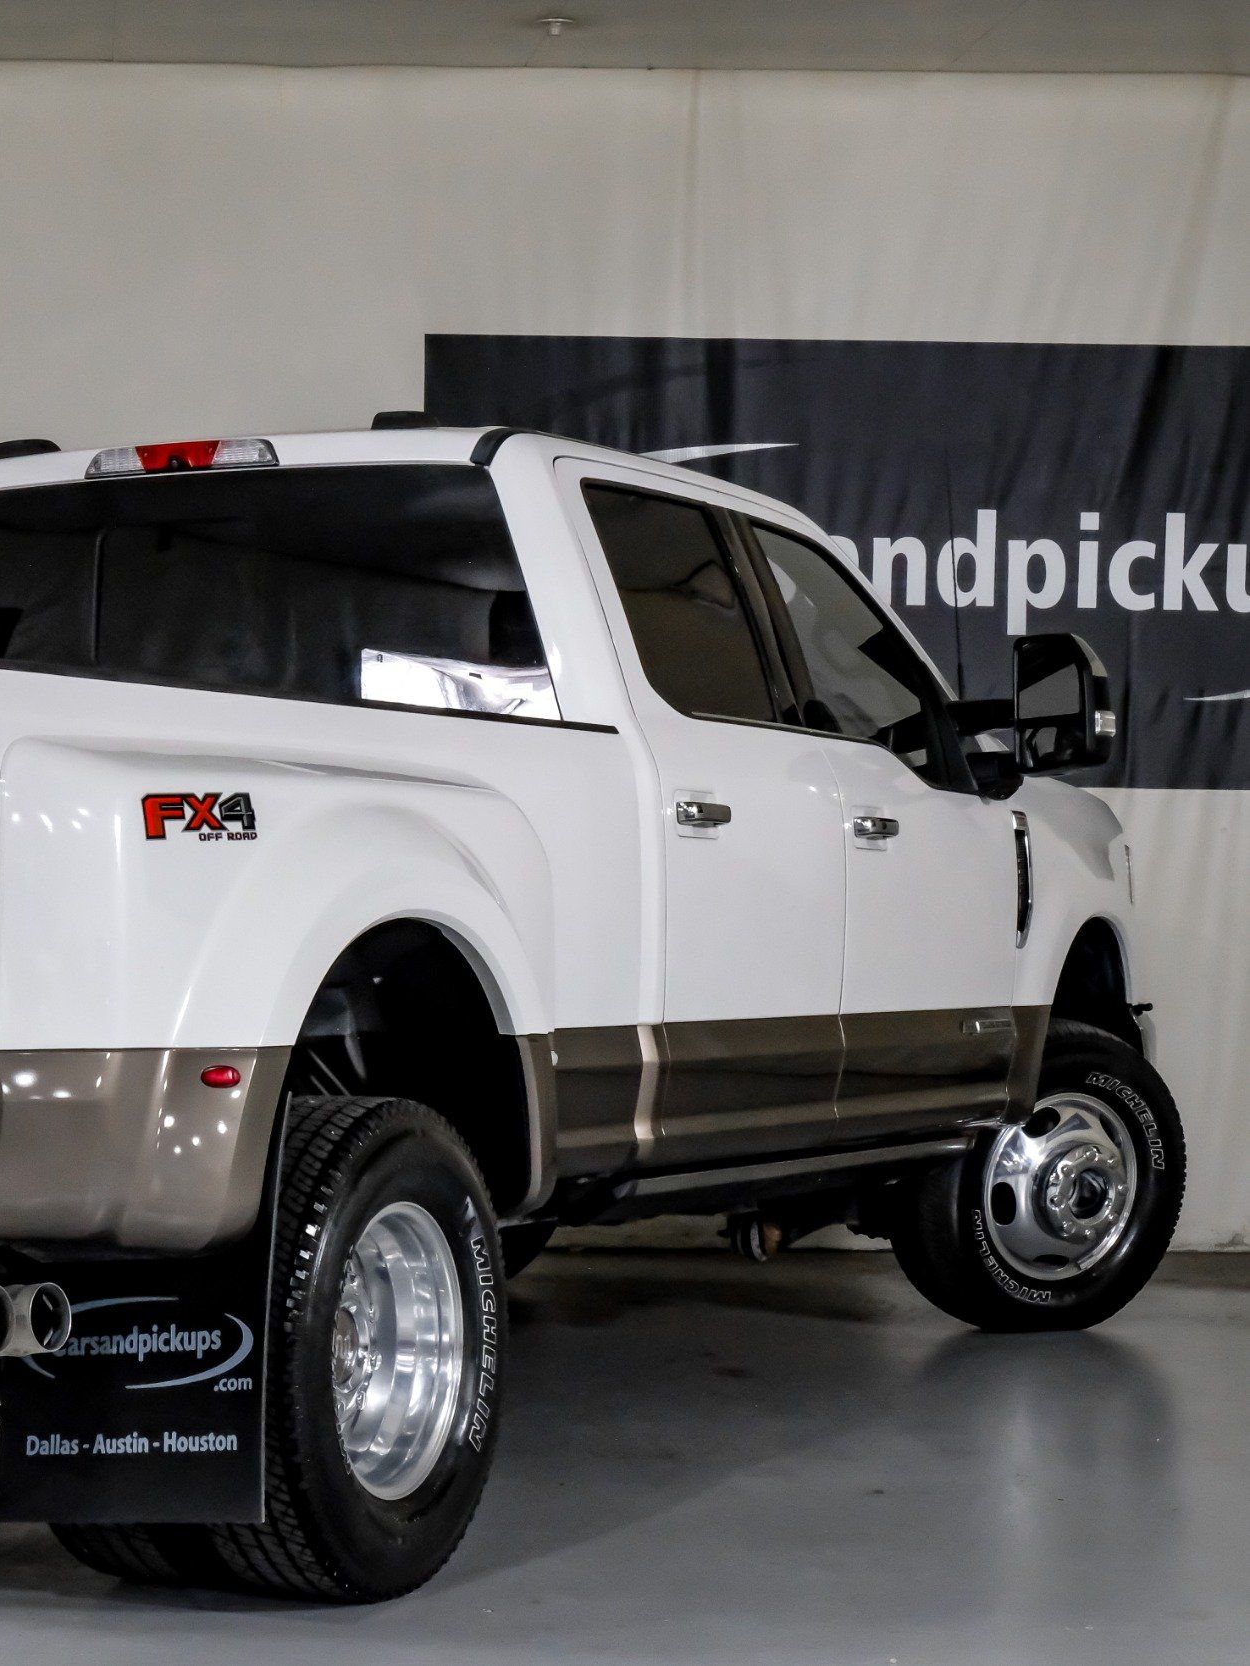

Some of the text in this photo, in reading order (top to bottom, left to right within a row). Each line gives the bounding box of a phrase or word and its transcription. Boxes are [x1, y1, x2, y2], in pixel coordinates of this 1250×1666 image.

[141, 792, 256, 840] FX4
[198, 831, 258, 841] OFF ROAD
[1086, 1071, 1165, 1170] MICHELIN
[973, 1209, 1051, 1303] MICHELIN
[469, 1237, 497, 1453] MICHELIN
[213, 1376, 253, 1392] .com
[25, 1434, 79, 1456] Dallas
[93, 1431, 149, 1455] Austin
[163, 1431, 238, 1453] Houston
